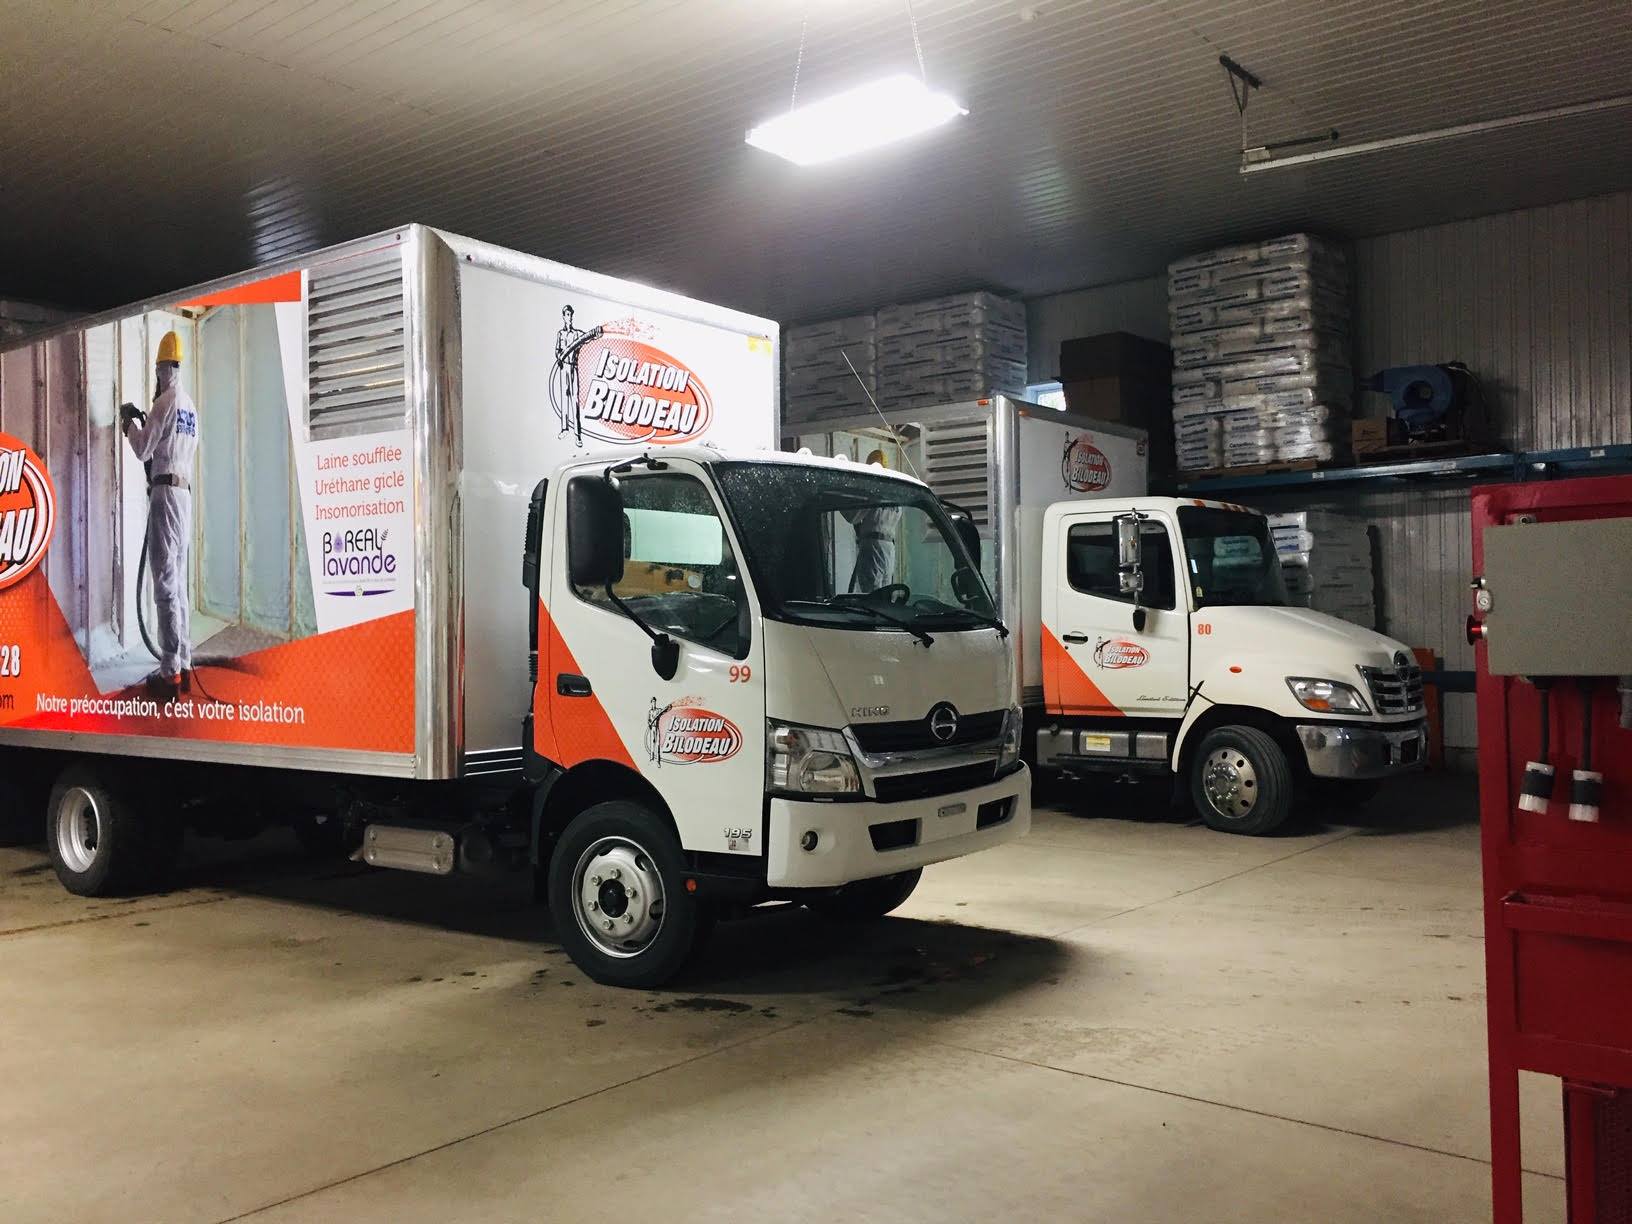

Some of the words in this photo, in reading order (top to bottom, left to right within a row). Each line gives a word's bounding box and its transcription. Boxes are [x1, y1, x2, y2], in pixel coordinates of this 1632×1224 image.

[594, 347, 691, 393] ISOLATION
[583, 378, 698, 434] BILODEAU
[316, 452, 349, 470] Laine
[315, 498, 405, 520] Insonorisation
[322, 552, 397, 577] lavande
[1197, 623, 1212, 636] 80
[1103, 653, 1145, 666] BILODEAU
[729, 665, 752, 683] 99
[36, 692, 68, 713] Notre
[70, 694, 161, 720] préoccupation,
[164, 697, 194, 719] c'est
[198, 699, 235, 720] votre
[238, 699, 305, 724] isolation
[667, 716, 725, 733] ISOLATION
[662, 732, 732, 756] BILODEAU
[724, 827, 753, 839] 195
